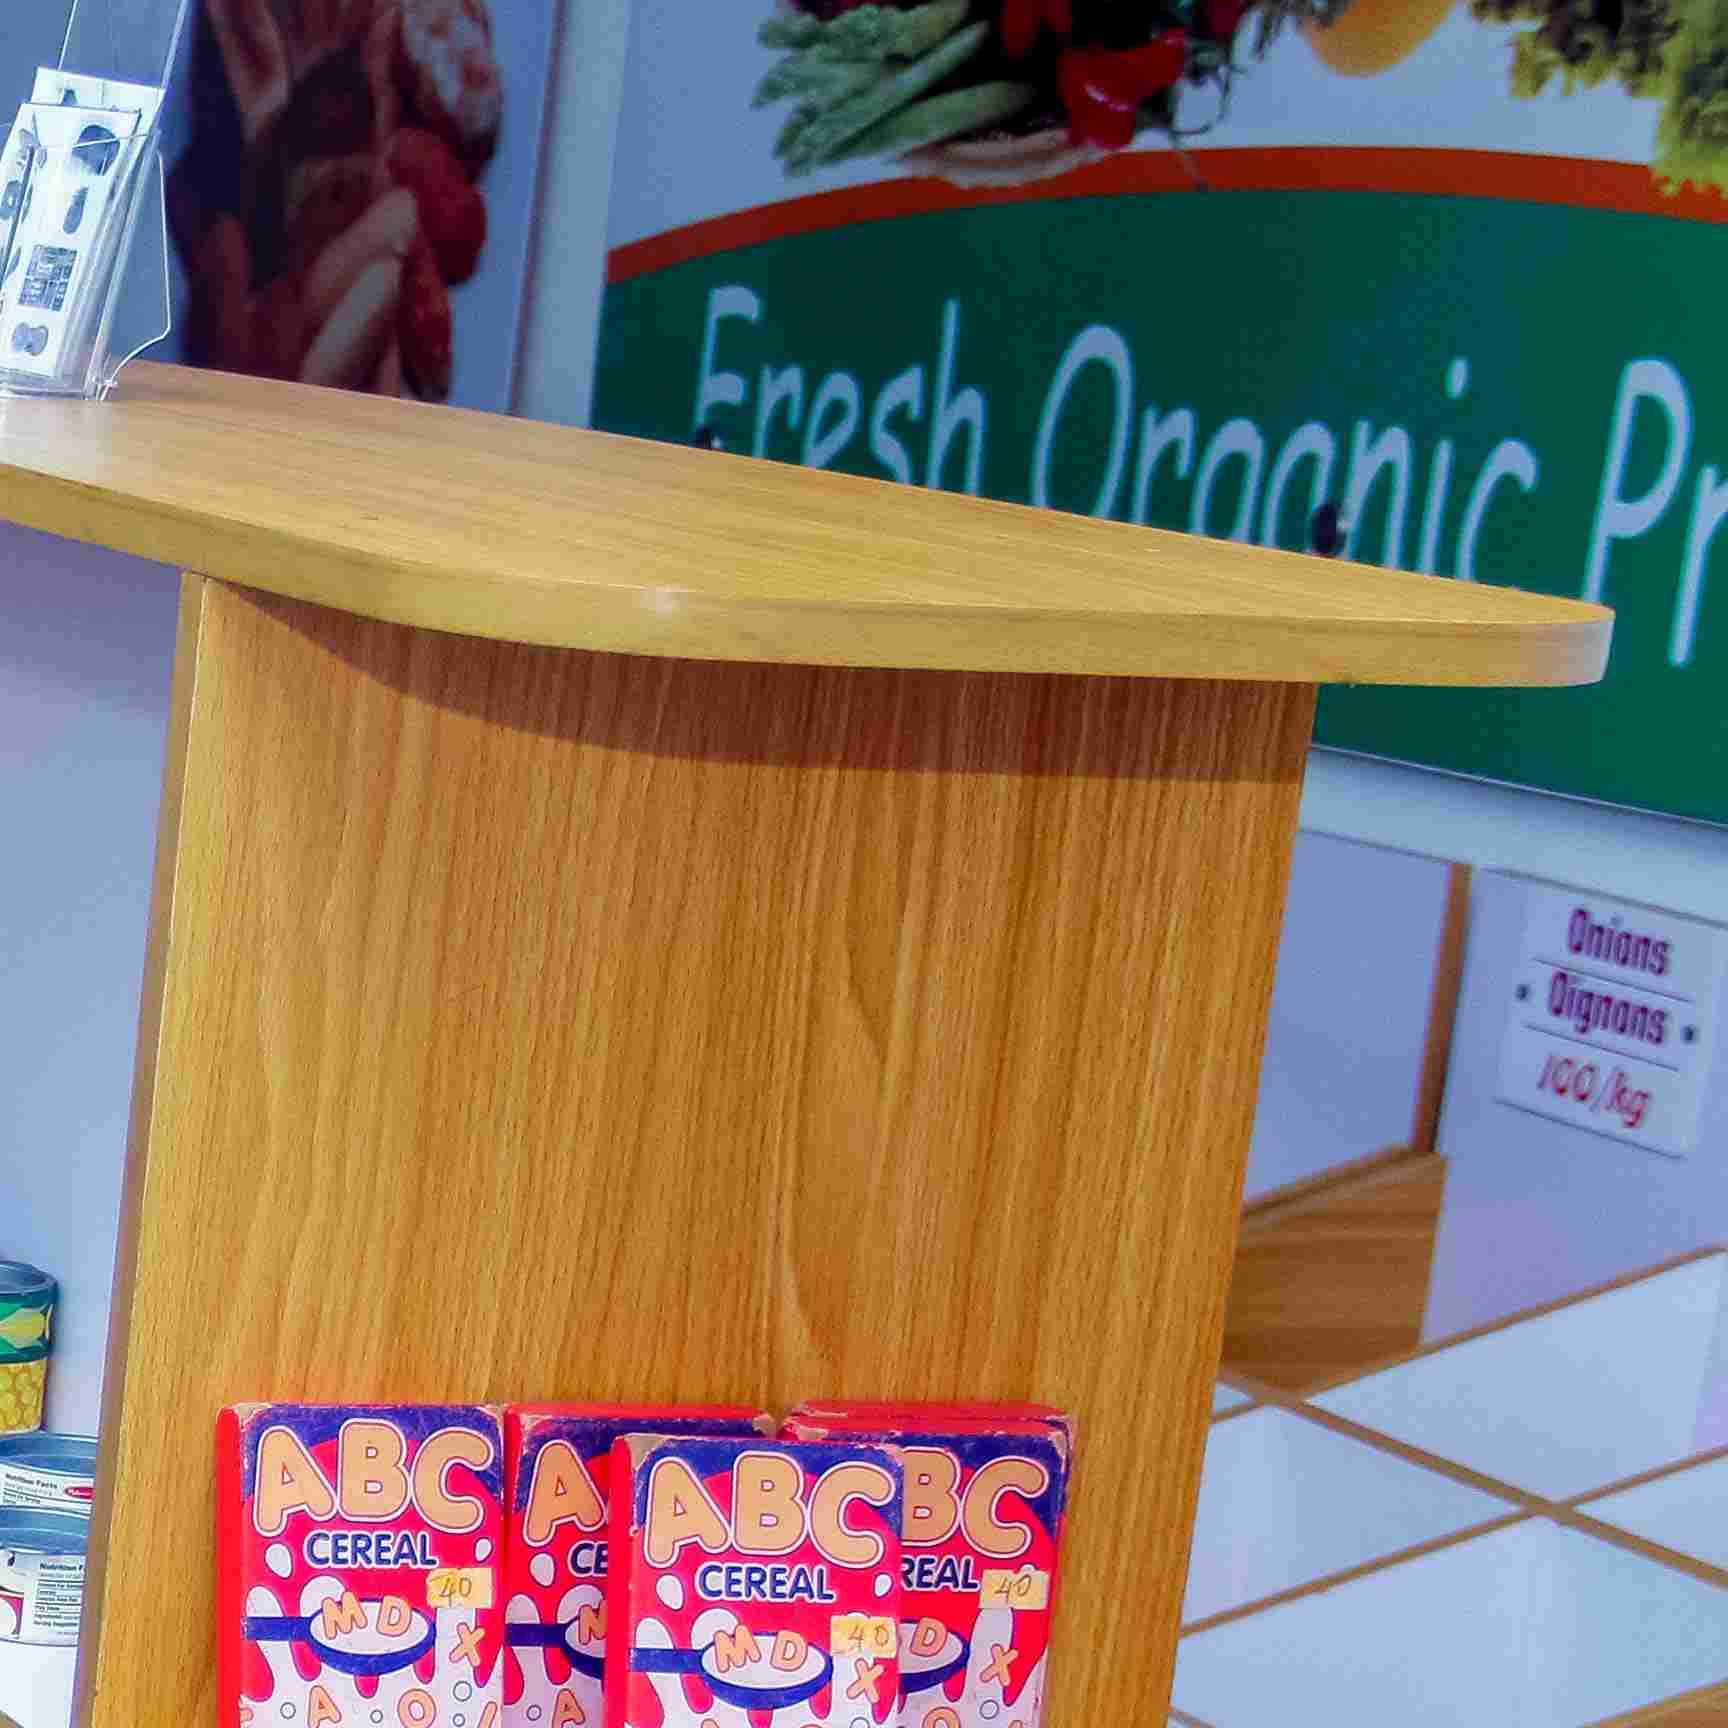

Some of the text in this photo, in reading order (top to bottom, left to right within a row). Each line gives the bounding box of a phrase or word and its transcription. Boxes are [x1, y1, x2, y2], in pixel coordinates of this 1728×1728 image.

[694, 286, 987, 497] Fresh
[1568, 908, 1671, 977] Onions
[1548, 970, 1666, 1045] Oignons
[1536, 1053, 1649, 1128] 100/kg
[253, 1417, 496, 1536] ABC
[644, 1450, 896, 1570] ABC
[900, 1445, 1050, 1559] BC
[303, 1531, 439, 1568] CEREAL
[695, 1561, 837, 1602] CEREAL
[437, 1575, 473, 1606] 40
[994, 1573, 1032, 1602] 40
[847, 1623, 891, 1654] 40
